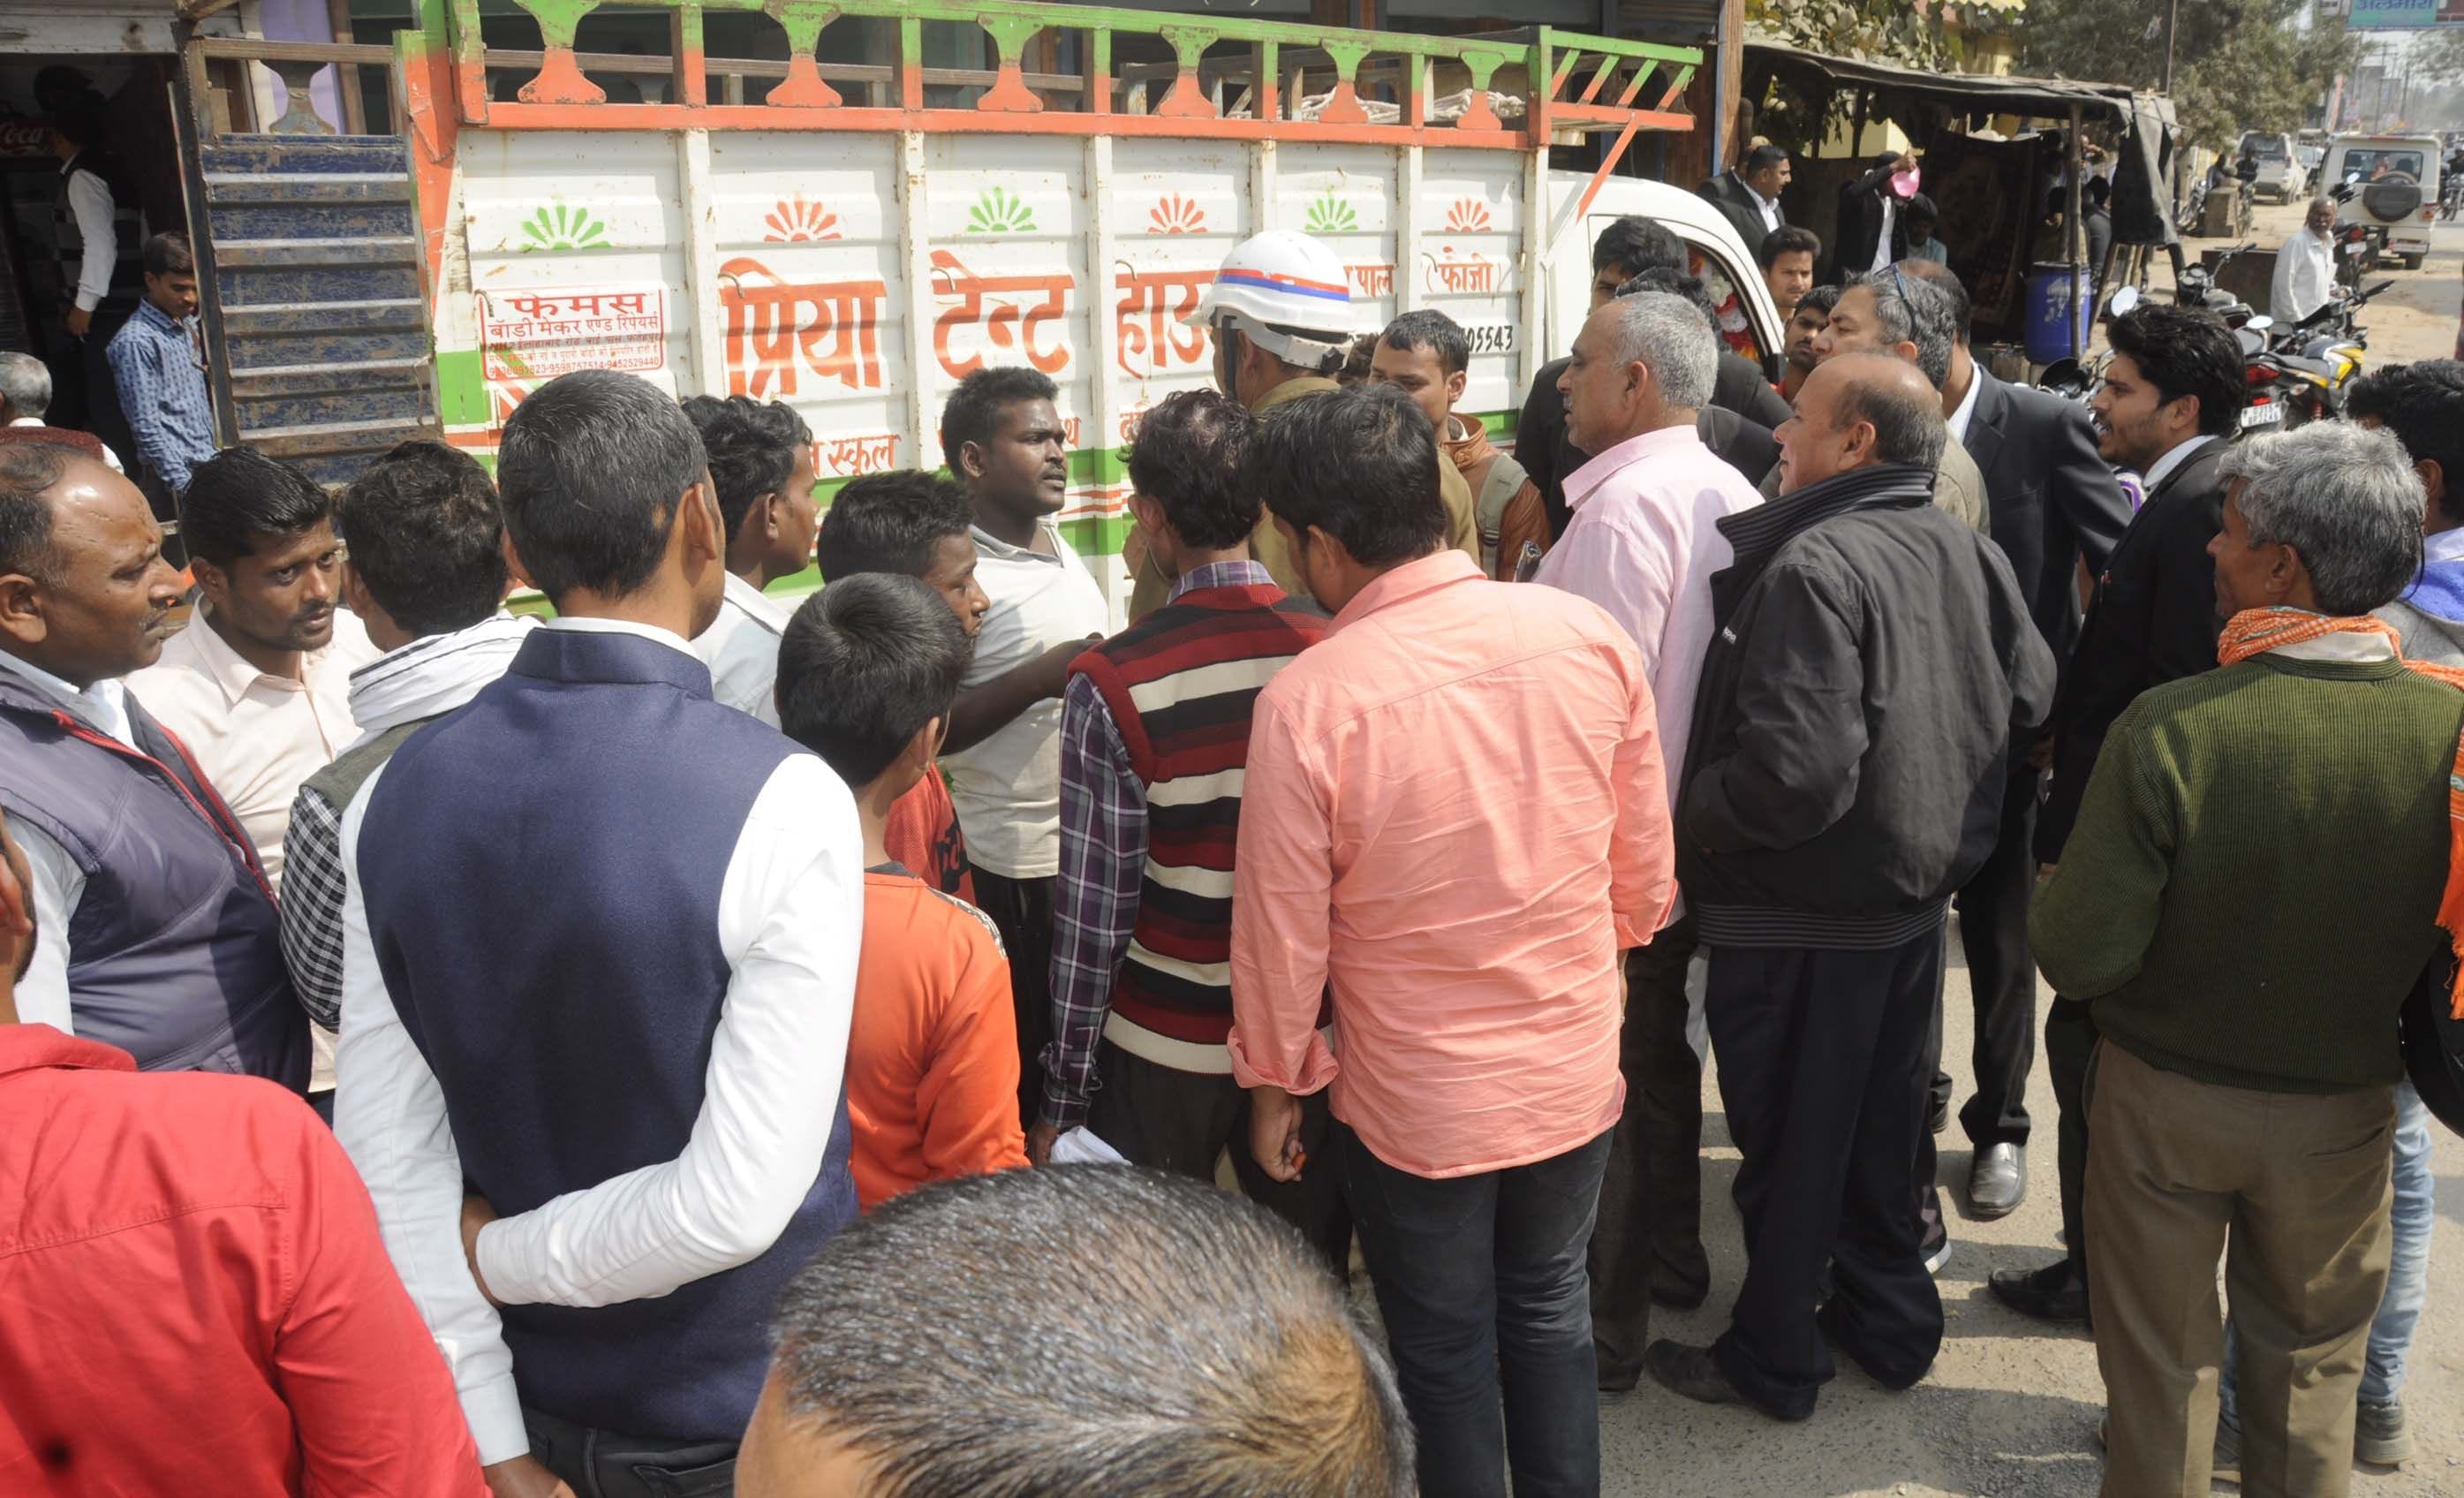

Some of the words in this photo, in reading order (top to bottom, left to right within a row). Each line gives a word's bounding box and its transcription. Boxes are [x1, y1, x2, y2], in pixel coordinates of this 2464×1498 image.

[537, 316, 581, 334] मेकर
[586, 318, 613, 332] एण्ड
[720, 257, 888, 398] प्रिया
[1115, 270, 1217, 380] हाउ
[1464, 325, 1513, 352] 05543
[828, 434, 901, 475] स्कूल
